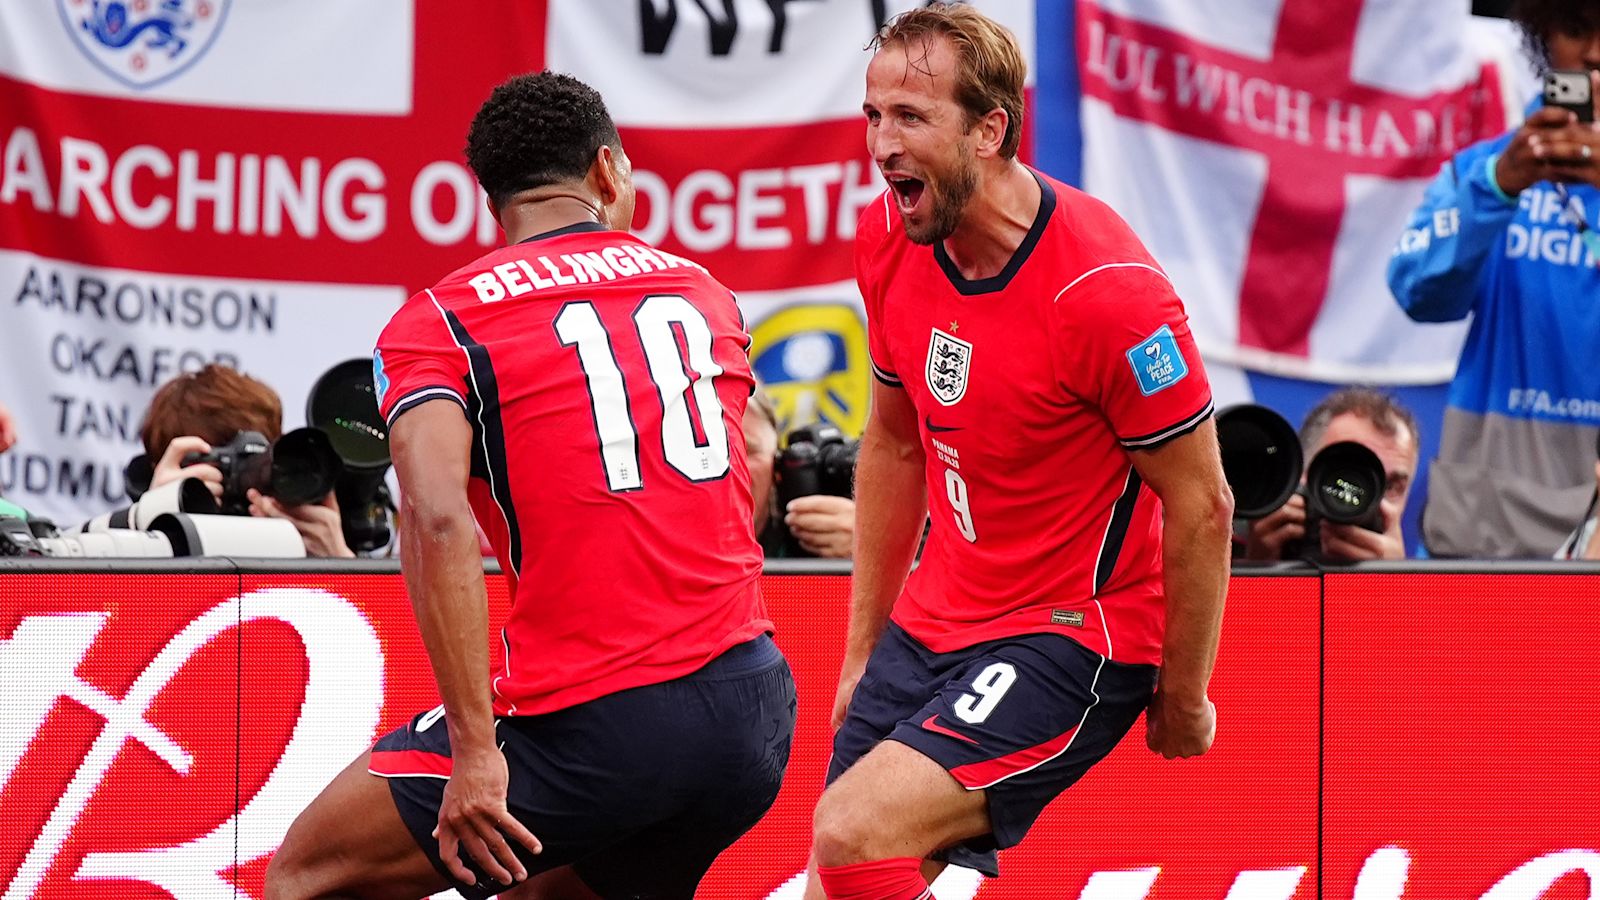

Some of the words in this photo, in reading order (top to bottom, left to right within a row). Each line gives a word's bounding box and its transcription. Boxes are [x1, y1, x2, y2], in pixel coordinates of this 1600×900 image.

[0, 126, 388, 243] ARCHING
[15, 266, 277, 333] AARONSON
[468, 245, 709, 304] BELLINGHA
[552, 294, 732, 492] 10
[1150, 362, 1174, 381] PEACE
[932, 437, 960, 460] PANAMA
[944, 468, 977, 543] 9
[952, 662, 1019, 724] 9
